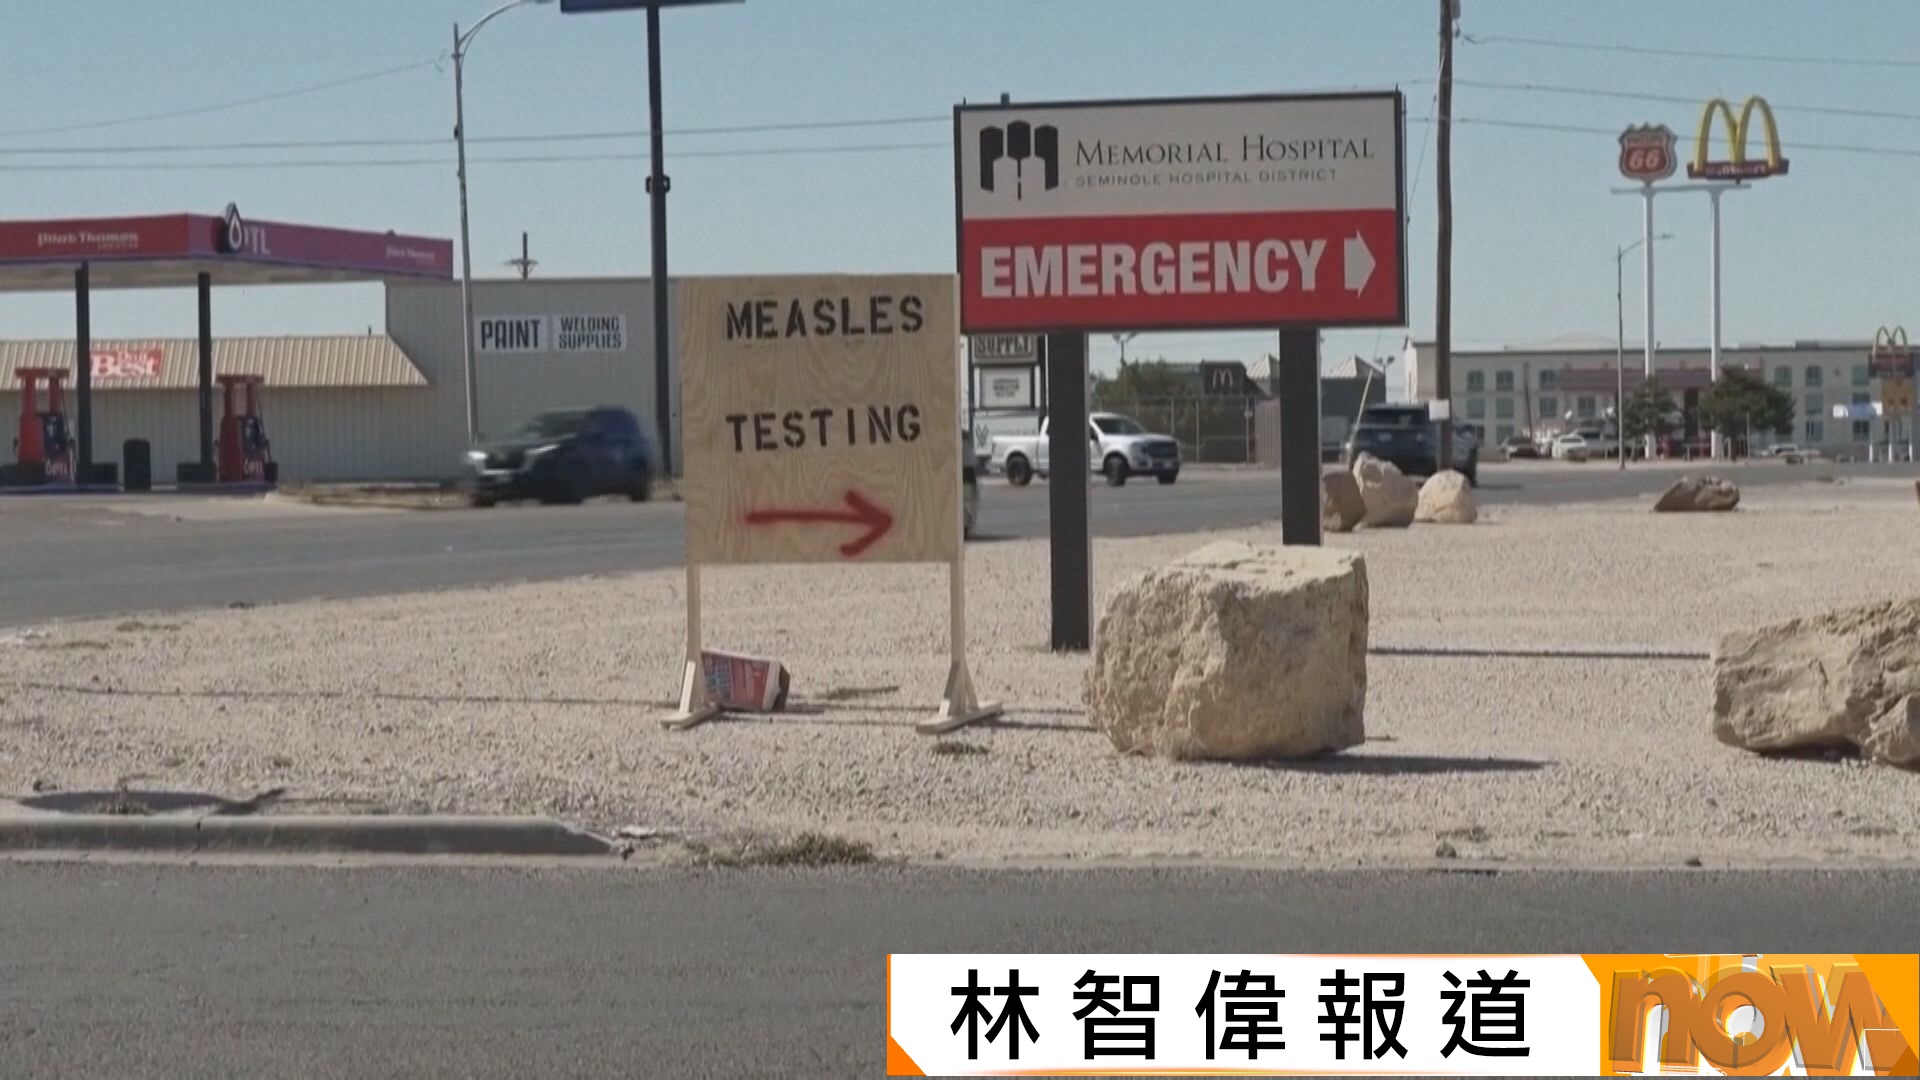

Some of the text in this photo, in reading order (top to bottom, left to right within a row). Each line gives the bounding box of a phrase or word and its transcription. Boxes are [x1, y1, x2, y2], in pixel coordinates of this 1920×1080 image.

[1076, 135, 1374, 167] MEMORIAL HOSPITAL
[1629, 149, 1660, 169] 66
[1076, 167, 1338, 188] SEMINOLE HOSPITAL DISTRICT
[980, 238, 1327, 299] EMERGENCY
[560, 316, 620, 332] WELDING
[726, 296, 924, 341] MEASLES
[480, 319, 541, 350] PAINT
[558, 333, 622, 350] SUPPLIES
[976, 336, 1033, 355] SUPPLY
[90, 354, 159, 378] Best
[726, 404, 921, 452] TESTING
